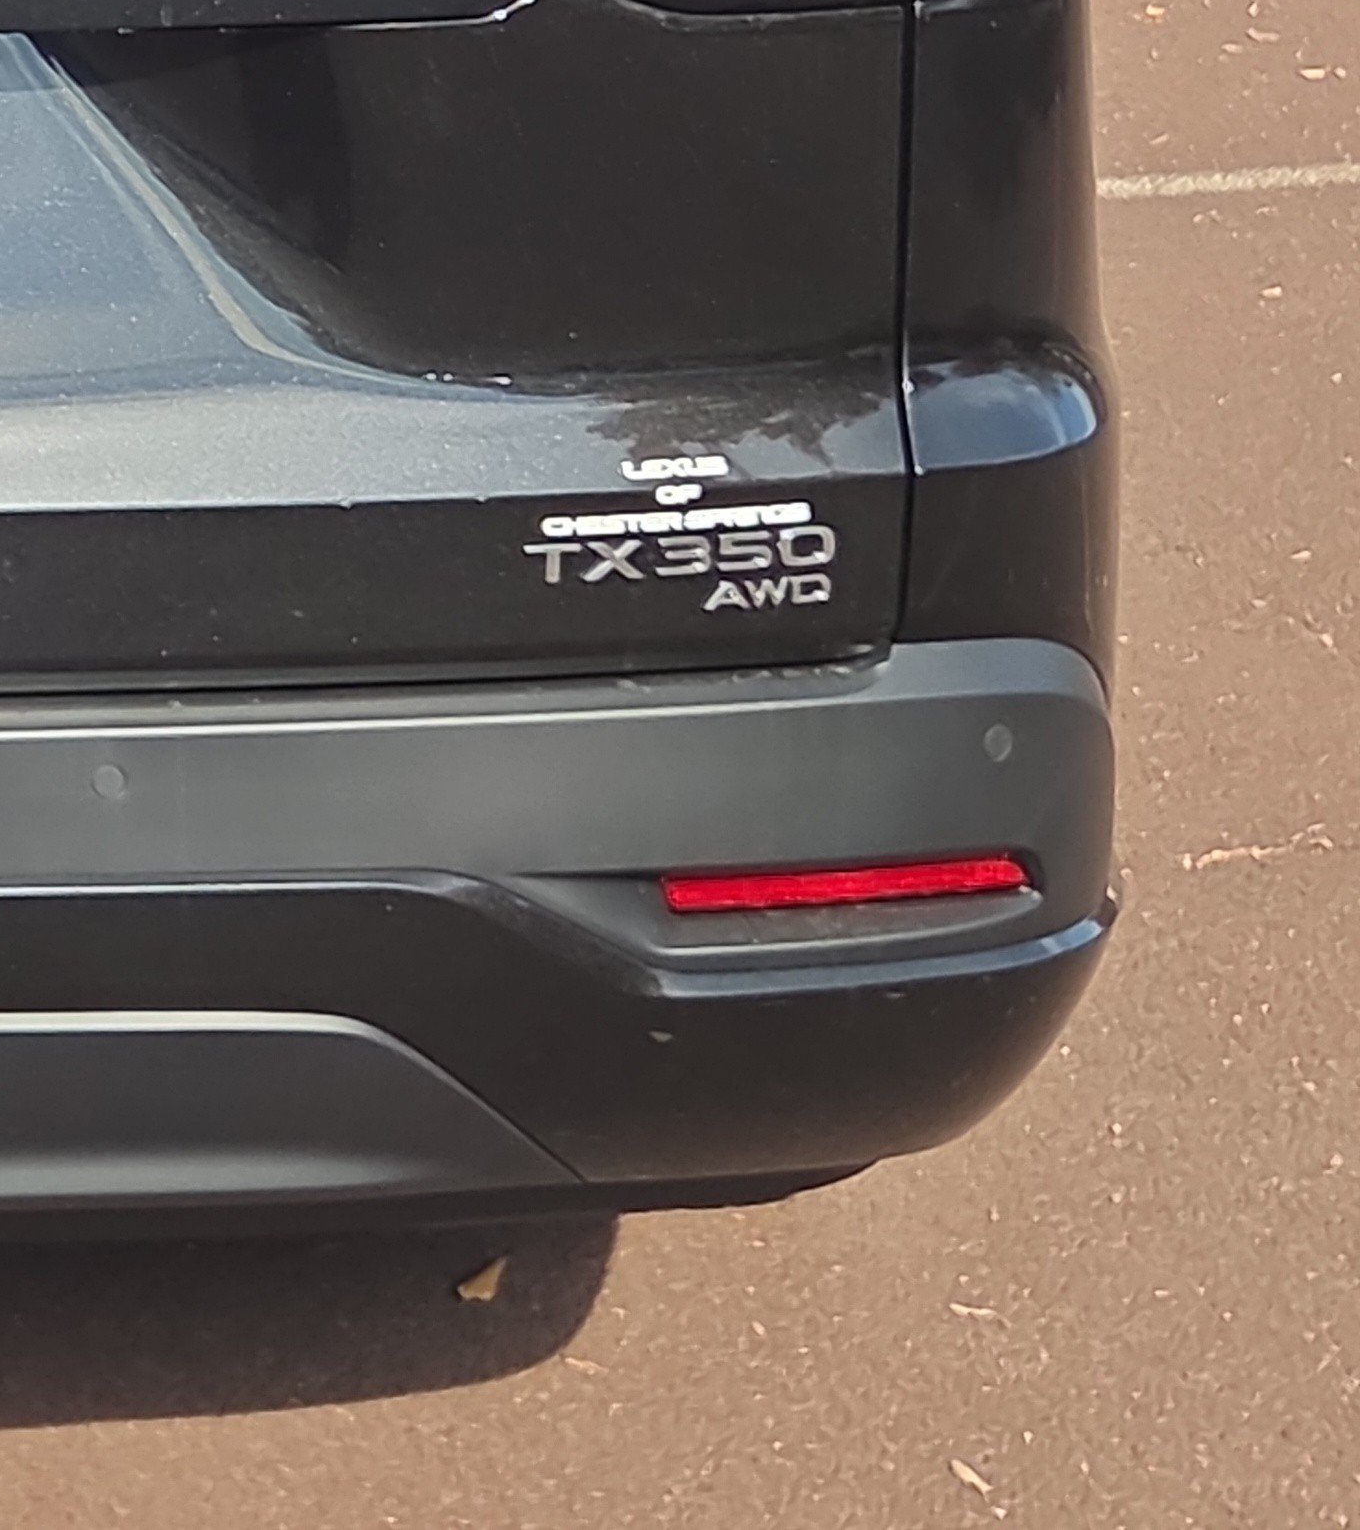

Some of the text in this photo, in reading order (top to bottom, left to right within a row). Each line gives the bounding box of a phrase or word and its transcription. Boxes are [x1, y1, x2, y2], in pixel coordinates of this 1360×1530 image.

[620, 456, 729, 481] LEXUS
[655, 483, 703, 505] OF
[702, 573, 831, 611] AWD
